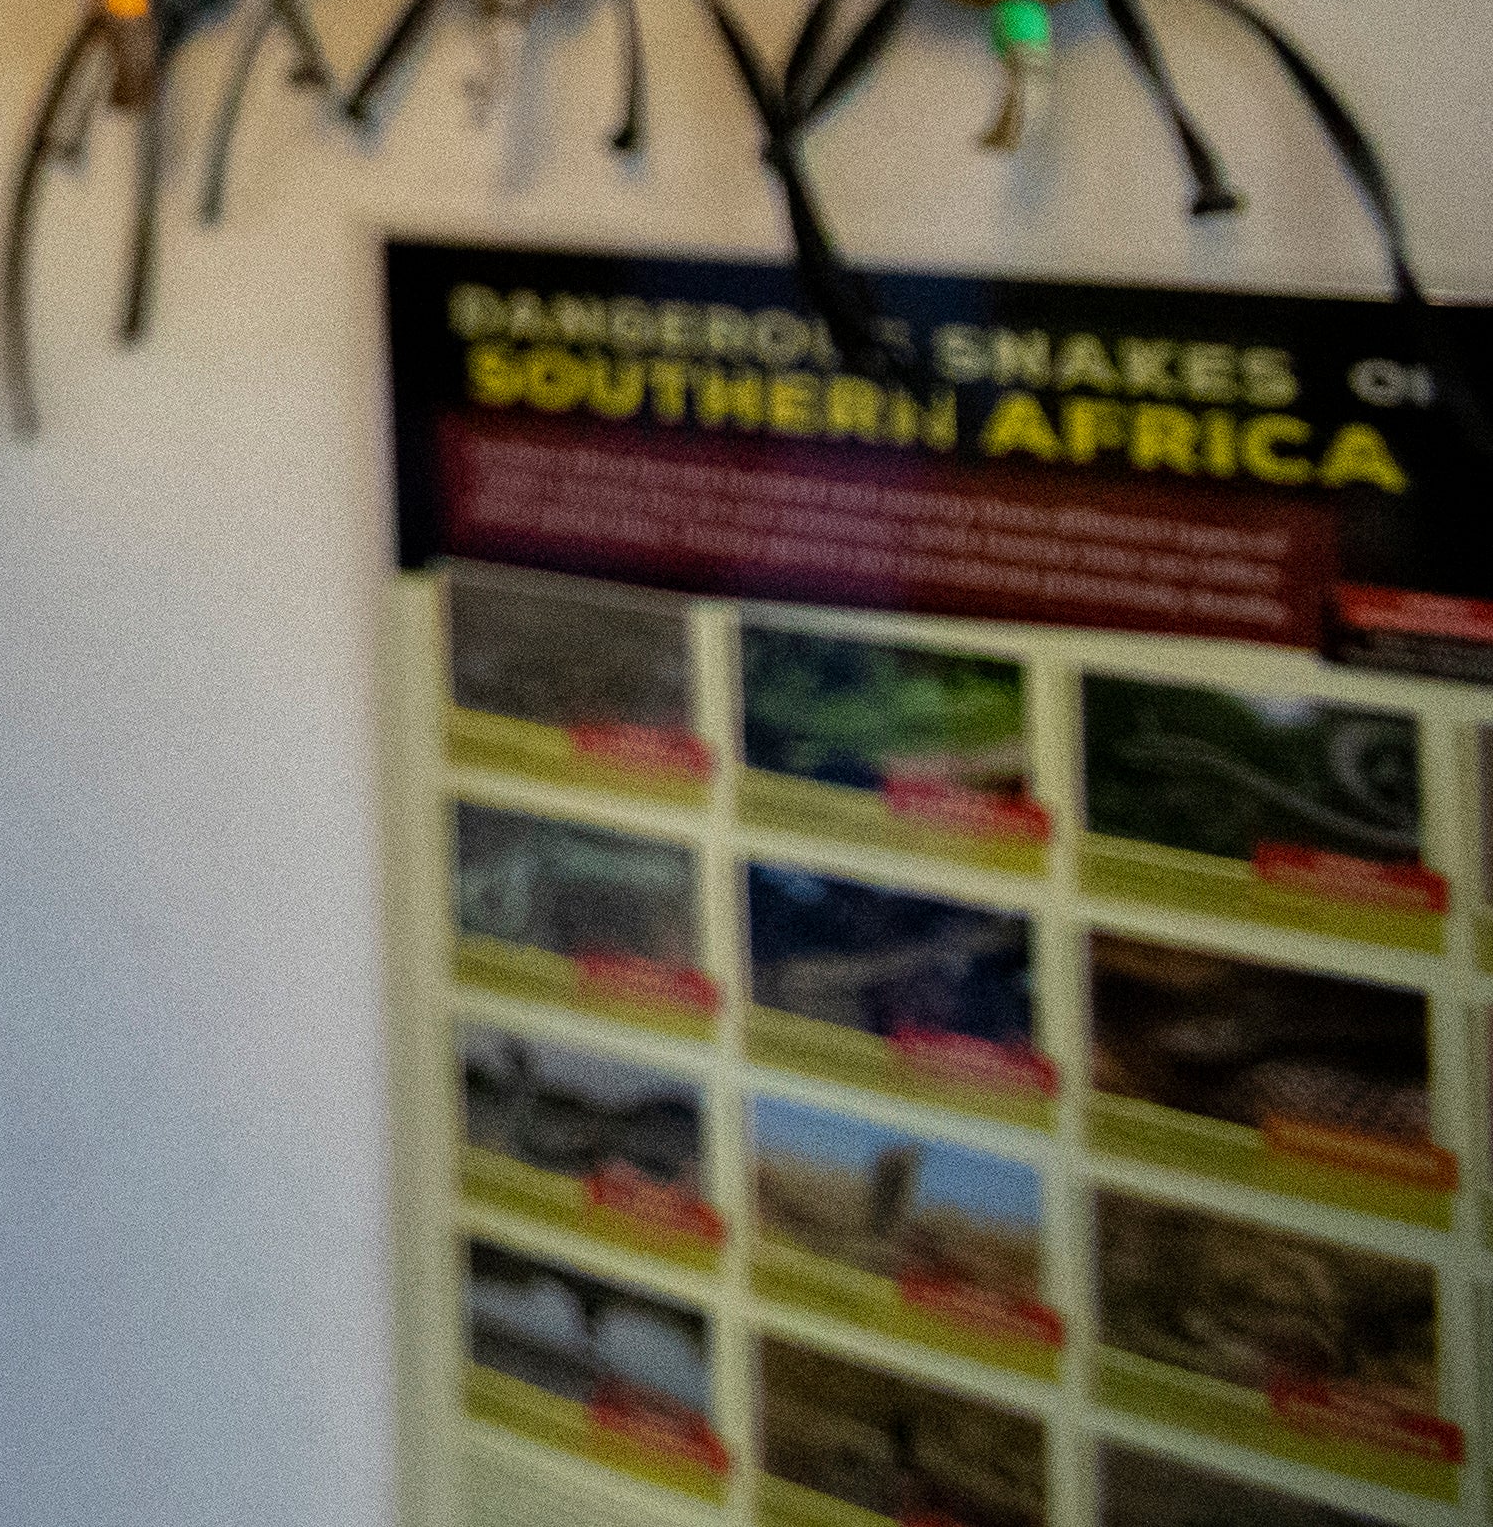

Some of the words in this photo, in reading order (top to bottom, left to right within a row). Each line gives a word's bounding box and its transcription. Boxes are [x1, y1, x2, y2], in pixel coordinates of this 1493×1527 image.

[466, 340, 957, 450] SOUTHERN
[981, 390, 1406, 494] AFRICA
[932, 323, 1298, 409] SNAKES
